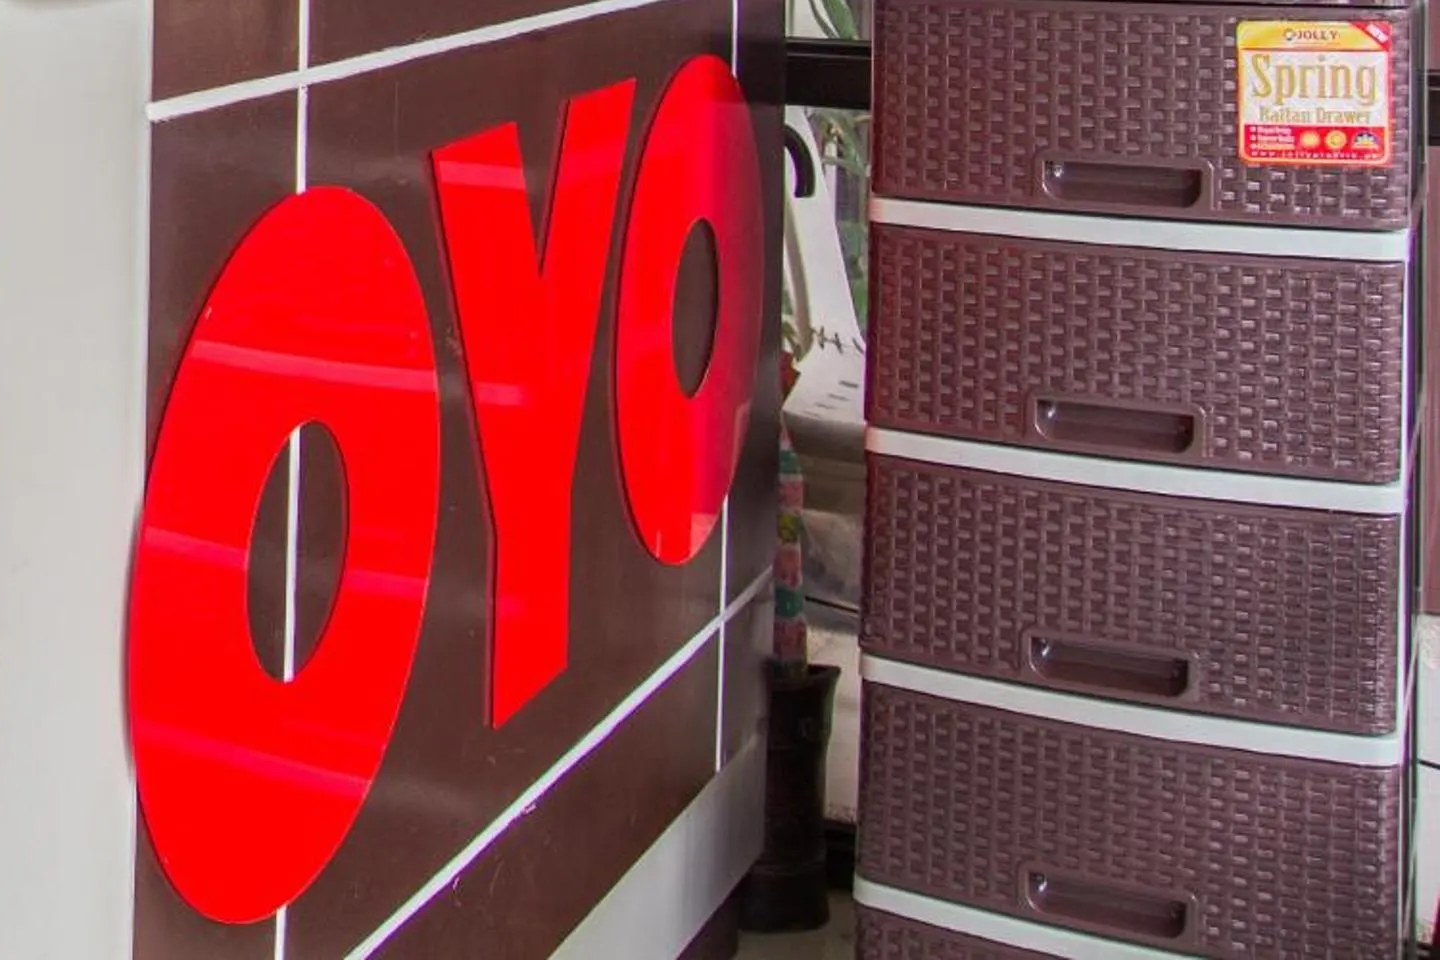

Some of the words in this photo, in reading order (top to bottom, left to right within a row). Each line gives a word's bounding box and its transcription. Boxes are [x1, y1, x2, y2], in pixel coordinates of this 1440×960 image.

[1297, 30, 1339, 41] JOLLY
[1251, 54, 1378, 106] Spring
[1316, 107, 1372, 125] Drawer
[126, 53, 763, 925] OYO
